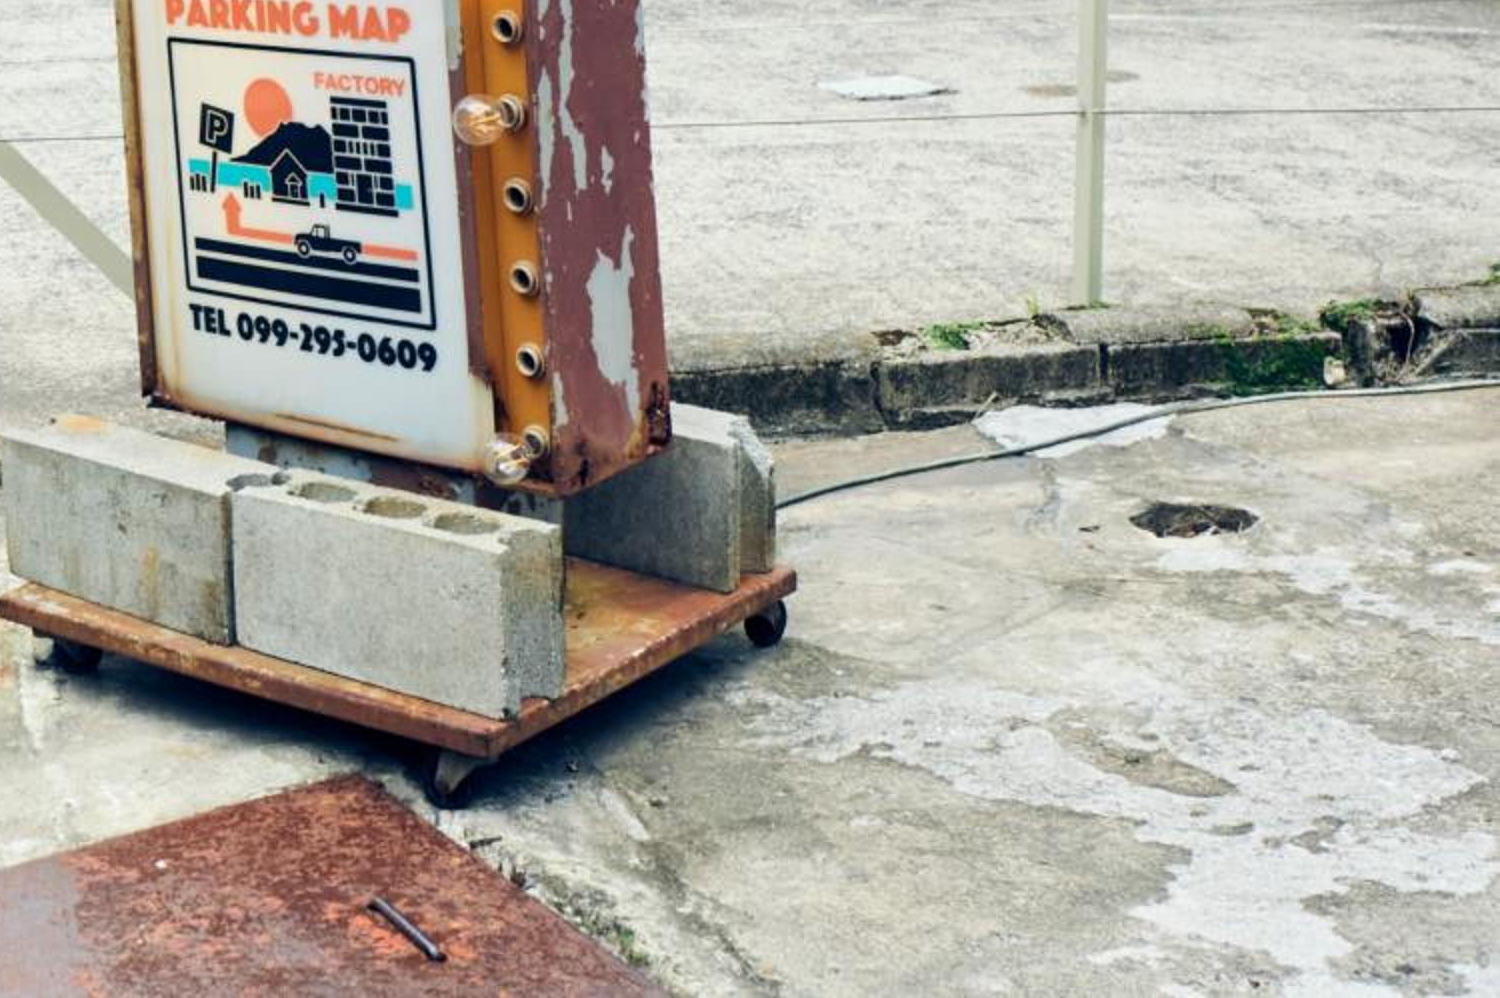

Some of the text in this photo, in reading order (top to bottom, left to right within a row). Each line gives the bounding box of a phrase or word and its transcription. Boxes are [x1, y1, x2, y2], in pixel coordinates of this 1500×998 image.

[328, 4, 411, 43] MAP
[313, 72, 406, 97] FACTORY
[205, 109, 229, 144] P
[189, 303, 438, 372] TEL 099-295-0609
